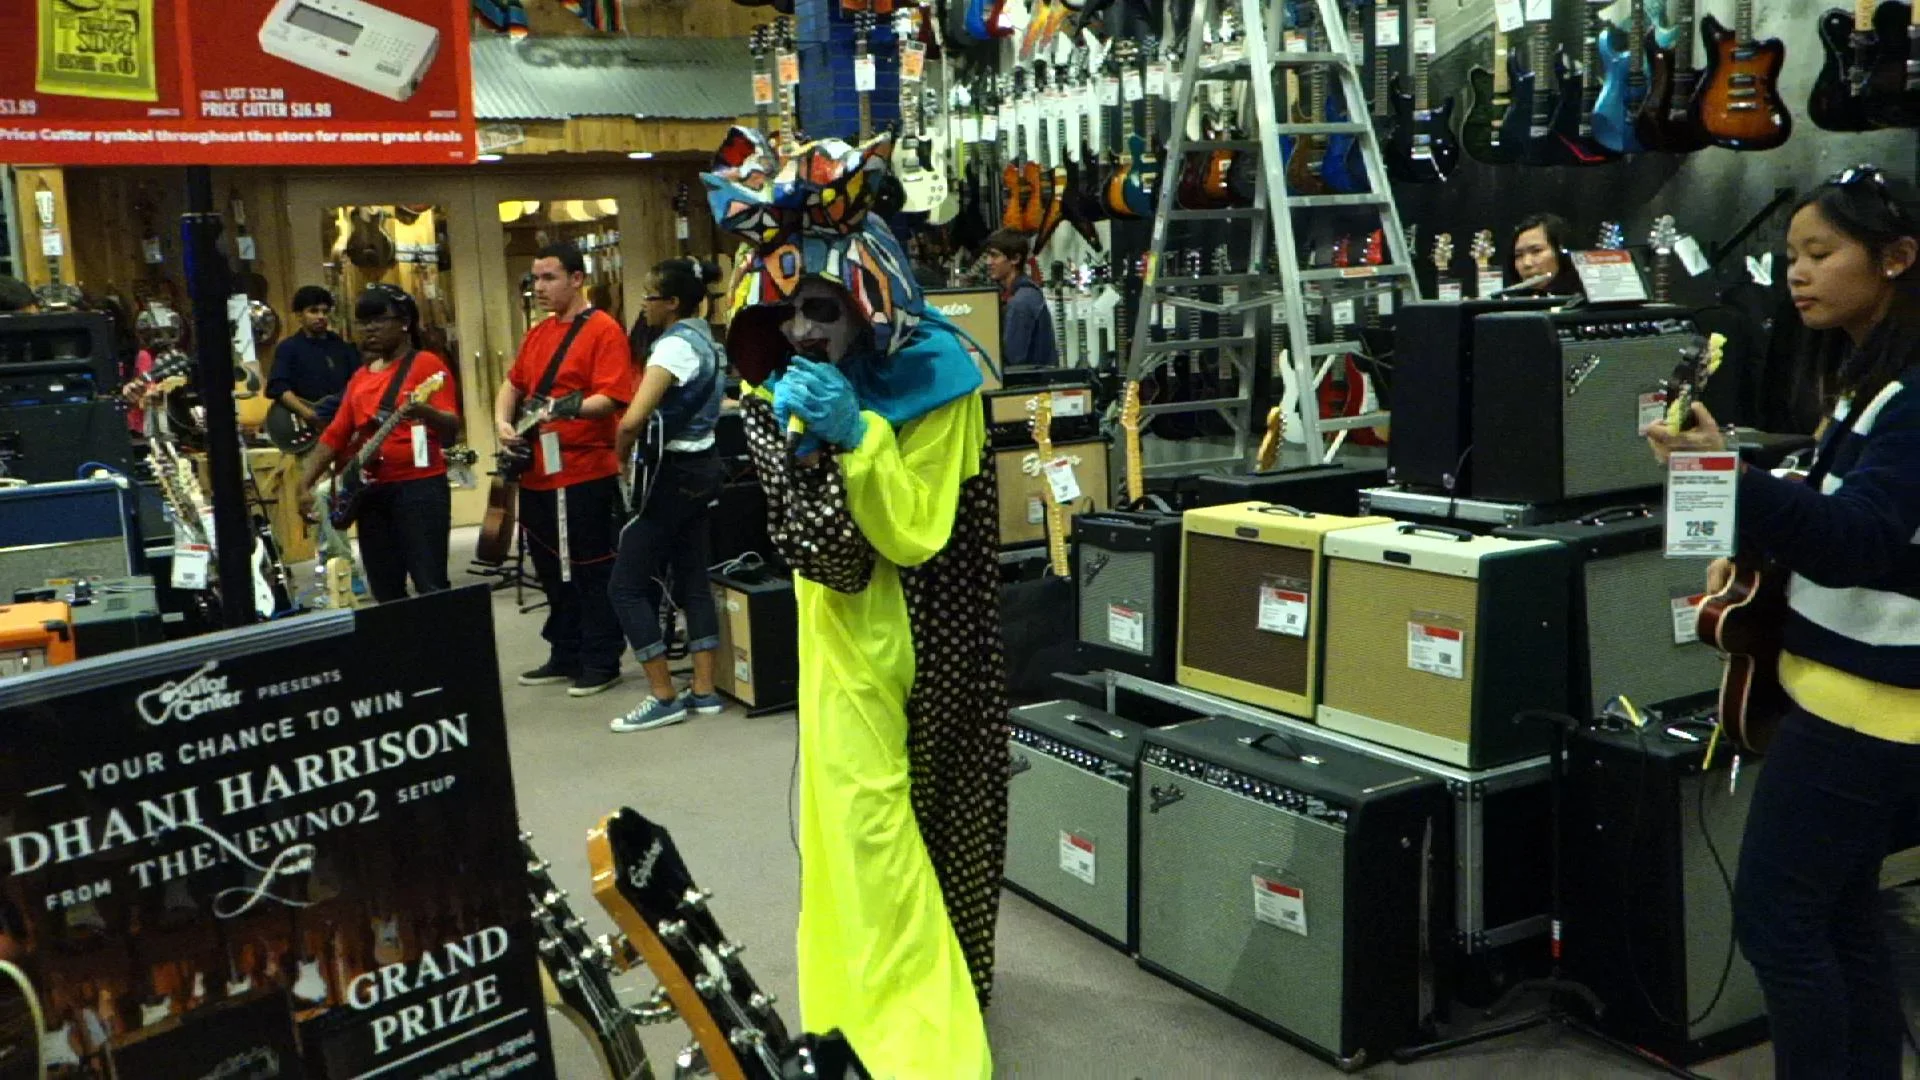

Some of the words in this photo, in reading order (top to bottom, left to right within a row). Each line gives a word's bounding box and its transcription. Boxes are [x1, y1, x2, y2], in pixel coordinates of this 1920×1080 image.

[39, 127, 92, 142] Cutter
[94, 128, 152, 144] symbol
[155, 129, 244, 145] throughout
[246, 130, 272, 142] the
[275, 131, 314, 142] store
[316, 129, 339, 142] for
[340, 131, 380, 142] more
[381, 131, 421, 145] great
[422, 129, 463, 142] deals
[202, 102, 239, 117] PRICE
[242, 102, 288, 117] CUTTER
[174, 689, 243, 721] Center
[257, 667, 342, 700] PRESENTS
[79, 751, 165, 790] YOUR
[178, 716, 296, 765] CHANCE
[307, 706, 340, 731] TO
[351, 690, 404, 720] WIN
[3, 786, 203, 877] DHANI
[214, 712, 470, 816] HARRISON
[46, 878, 113, 910] FROM
[398, 774, 456, 804] SETUP
[346, 924, 509, 1010] GRAND
[371, 974, 502, 1055] PRIZE
